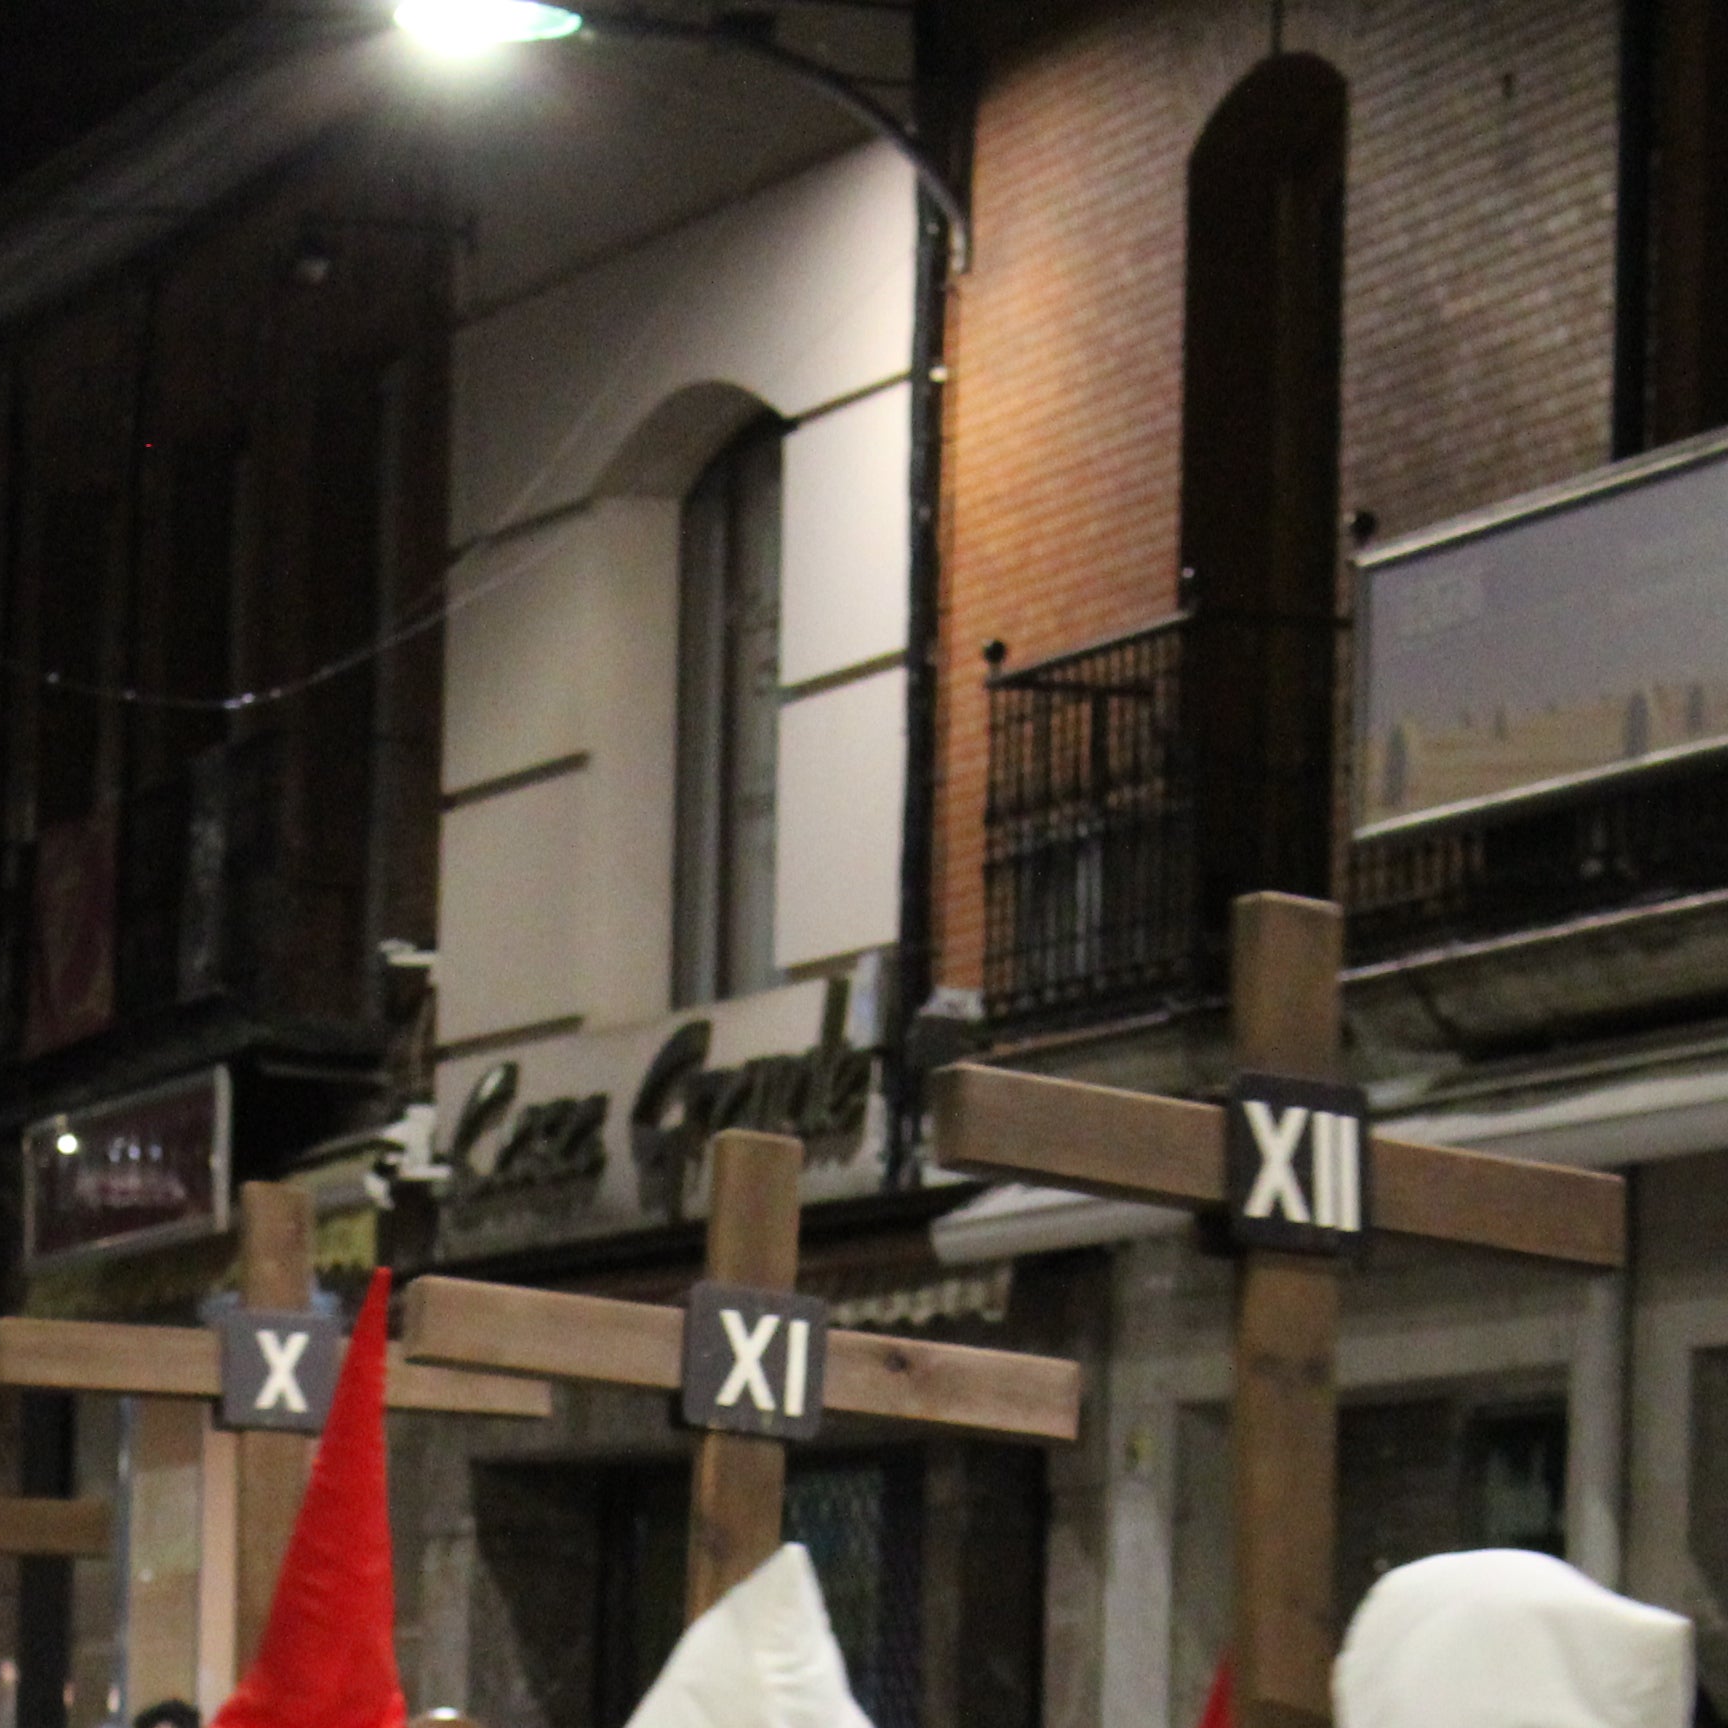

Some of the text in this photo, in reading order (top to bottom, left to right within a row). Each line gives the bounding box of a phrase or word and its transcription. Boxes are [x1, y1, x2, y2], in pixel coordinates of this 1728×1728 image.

[1242, 1100, 1361, 1232] XII
[254, 1329, 310, 1414] X
[715, 1309, 810, 1417] XI
